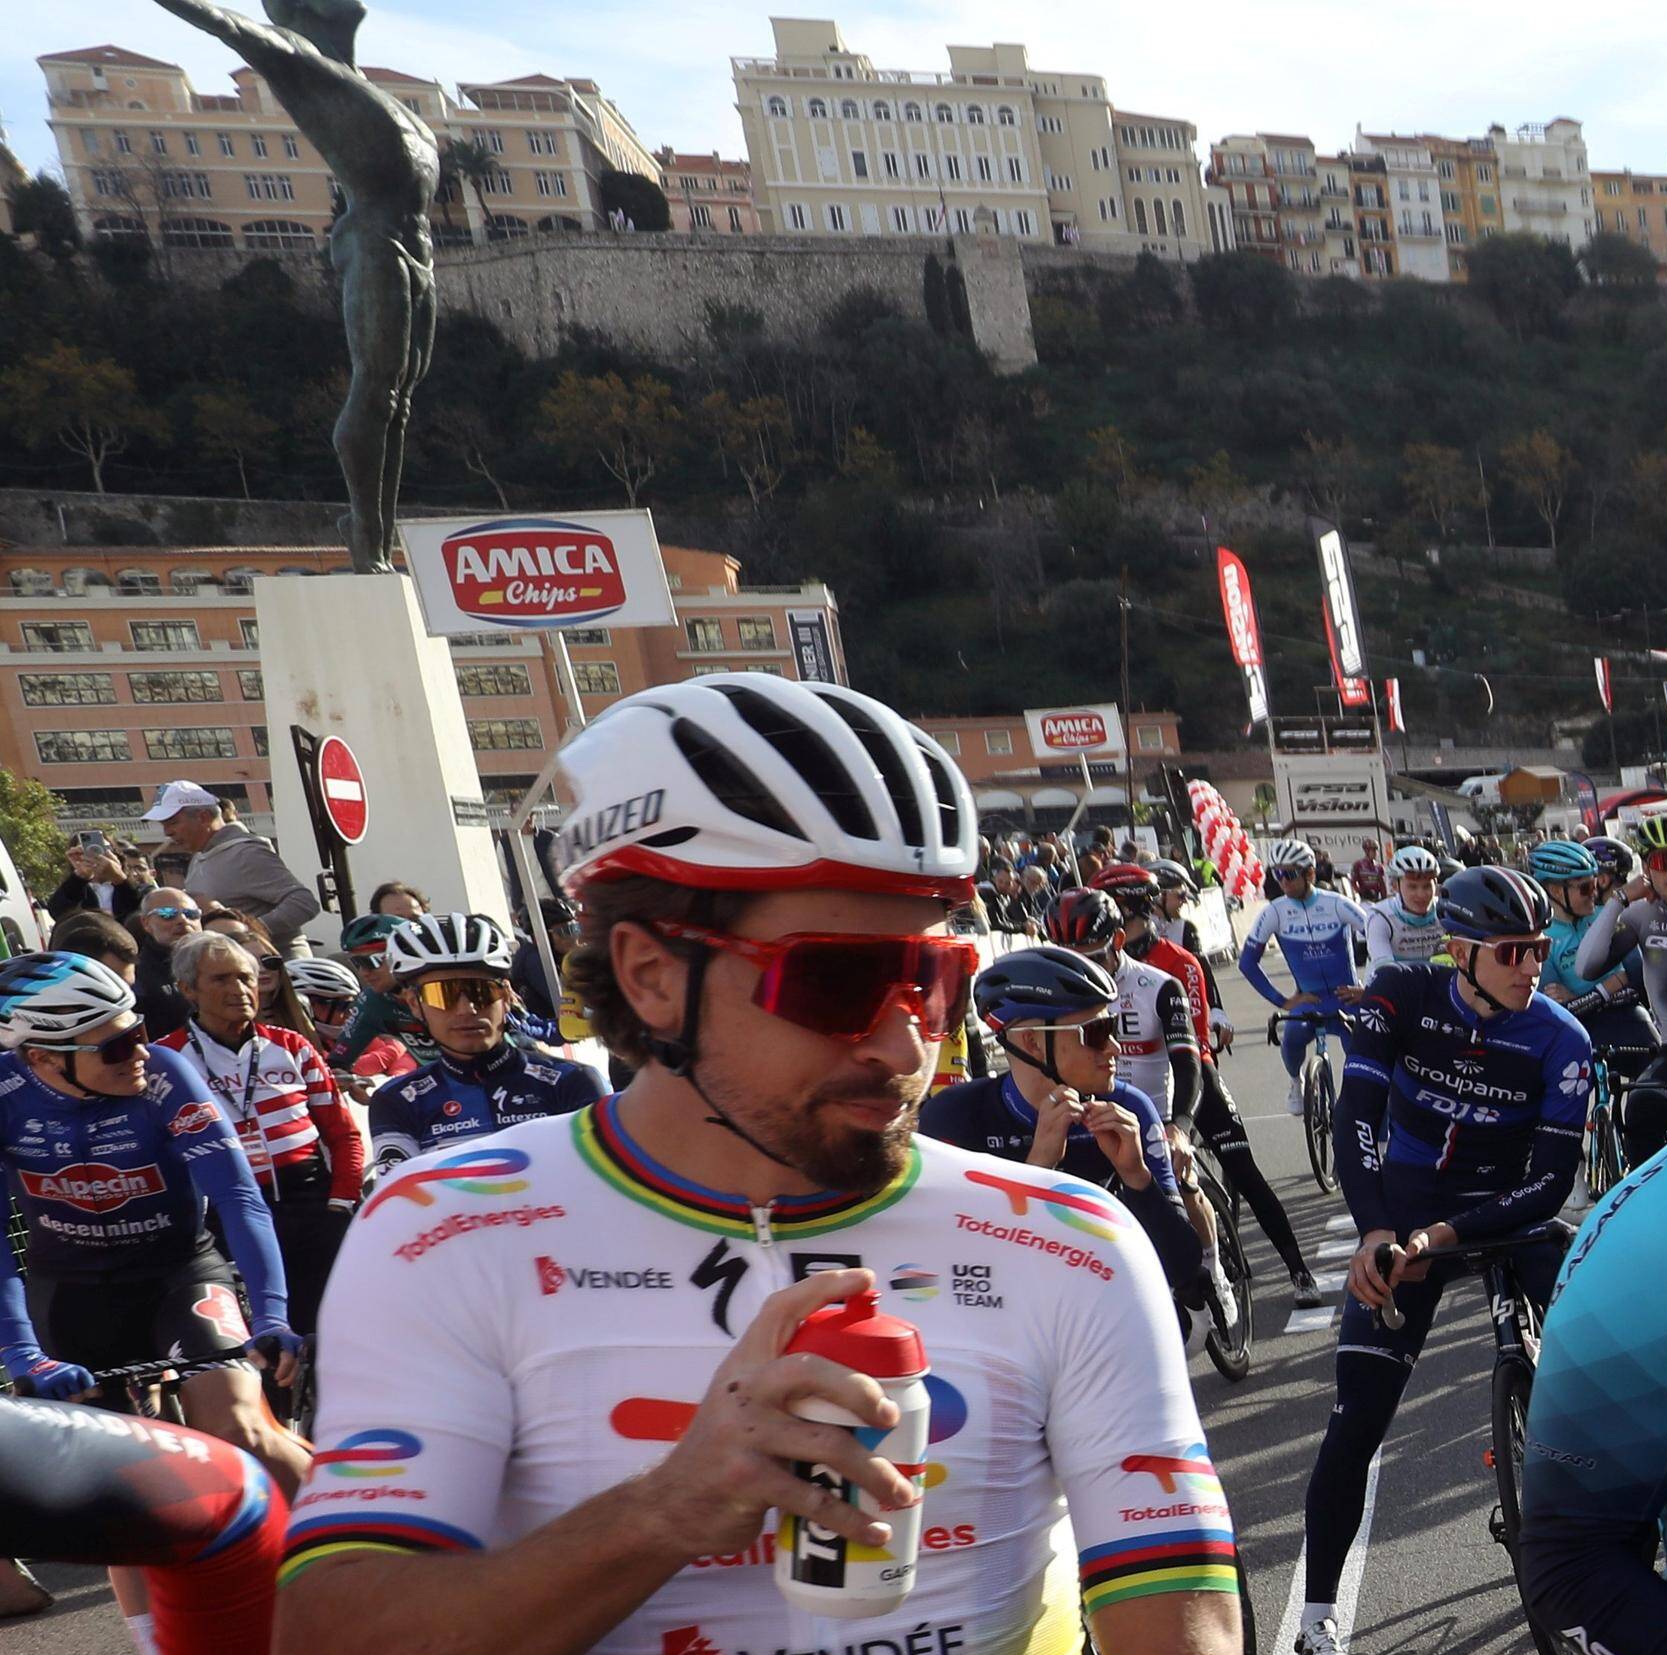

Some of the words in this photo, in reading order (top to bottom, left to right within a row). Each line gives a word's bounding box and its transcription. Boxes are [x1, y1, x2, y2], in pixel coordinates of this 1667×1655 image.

[456, 544, 614, 585] AMICA
[506, 580, 579, 611] Chips
[1044, 716, 1103, 737] AMICA
[1061, 732, 1091, 747] Chips
[1296, 797, 1370, 812] Vision
[1283, 922, 1339, 934] Jayco
[1403, 1055, 1528, 1101] Groupama
[1415, 1089, 1469, 1118] FDJ
[431, 1117, 481, 1136] Ekopak
[1354, 1119, 1377, 1156] FDJ
[40, 1174, 148, 1201] Alpecin
[38, 1210, 172, 1238] deceuninck
[393, 1203, 567, 1263] TotalEnergies
[954, 1213, 1116, 1282] TotalEnergies
[569, 1267, 675, 1290] VENDÉE
[952, 1264, 991, 1279] UCI
[952, 1279, 991, 1293] PRO
[953, 1293, 1005, 1309] TEAM
